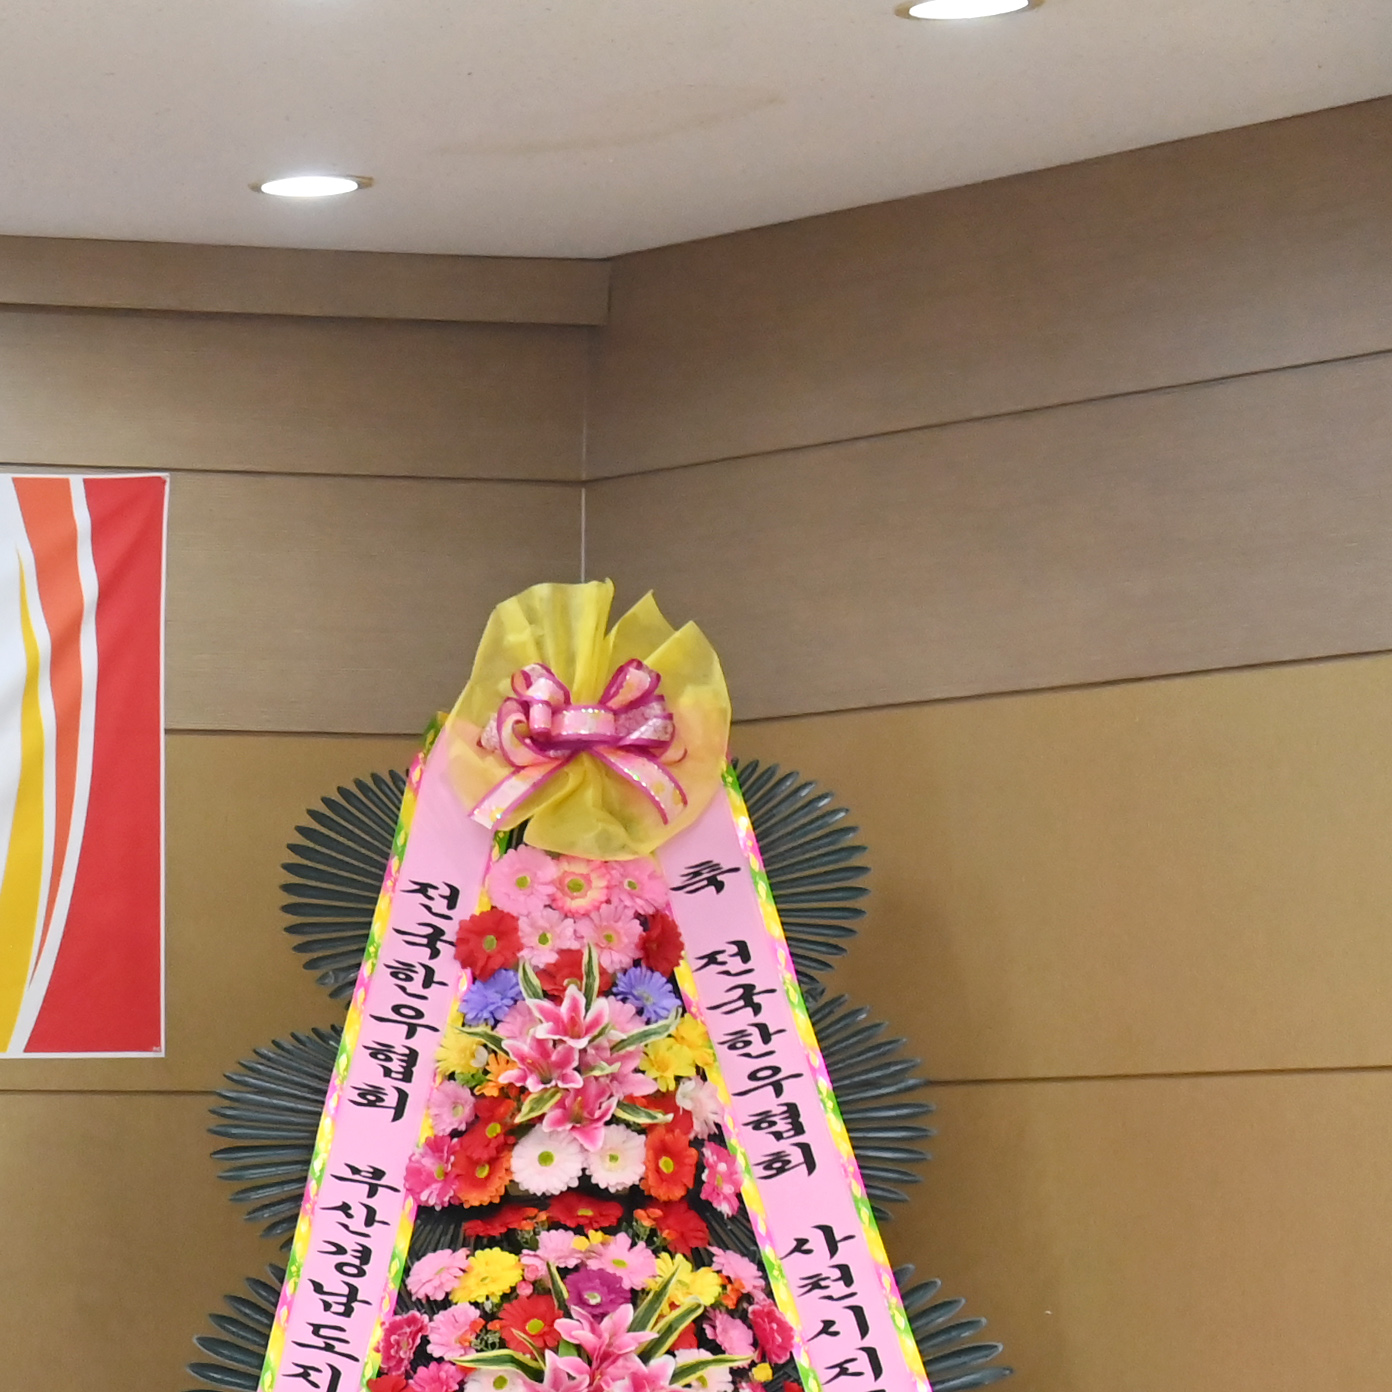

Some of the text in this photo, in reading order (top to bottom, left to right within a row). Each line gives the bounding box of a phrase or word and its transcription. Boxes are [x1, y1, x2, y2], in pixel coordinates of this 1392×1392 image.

[669, 860, 741, 895] 축
[348, 879, 461, 1123] 전국한우협회
[693, 939, 816, 1180] 전국한우협회
